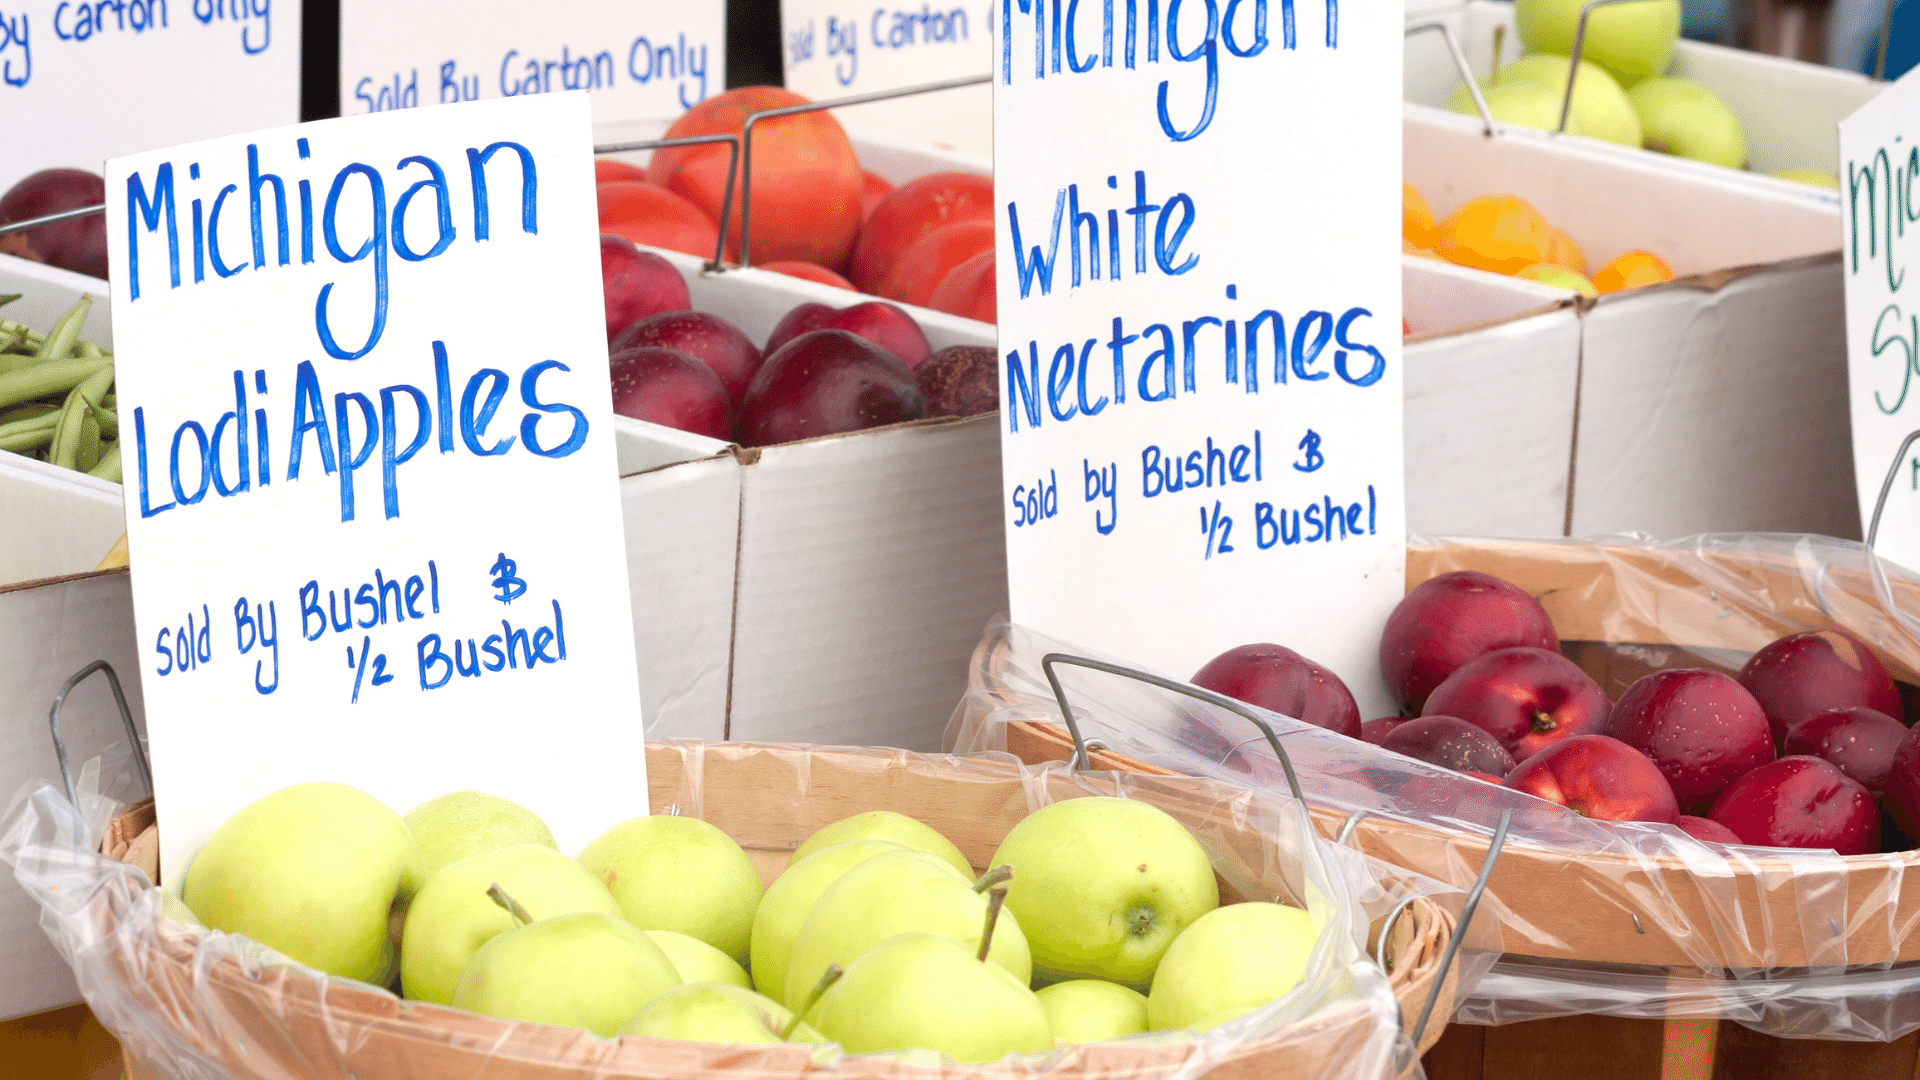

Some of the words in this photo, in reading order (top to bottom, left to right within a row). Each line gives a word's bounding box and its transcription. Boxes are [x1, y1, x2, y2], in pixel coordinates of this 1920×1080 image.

[0, 10, 32, 88] y
[871, 4, 969, 49] Carton
[500, 47, 614, 98] Carton
[627, 34, 708, 113] Only
[127, 138, 538, 362] Michigan
[1007, 170, 1201, 300] White
[1006, 284, 1387, 434] Nectarines
[134, 369, 271, 519] Lodi
[287, 340, 589, 523] Apples
[1142, 430, 1262, 499] Bushel
[1255, 485, 1377, 550] Bushel
[234, 597, 279, 695] By
[299, 560, 440, 642] Bushel
[417, 599, 566, 692] Bushel
